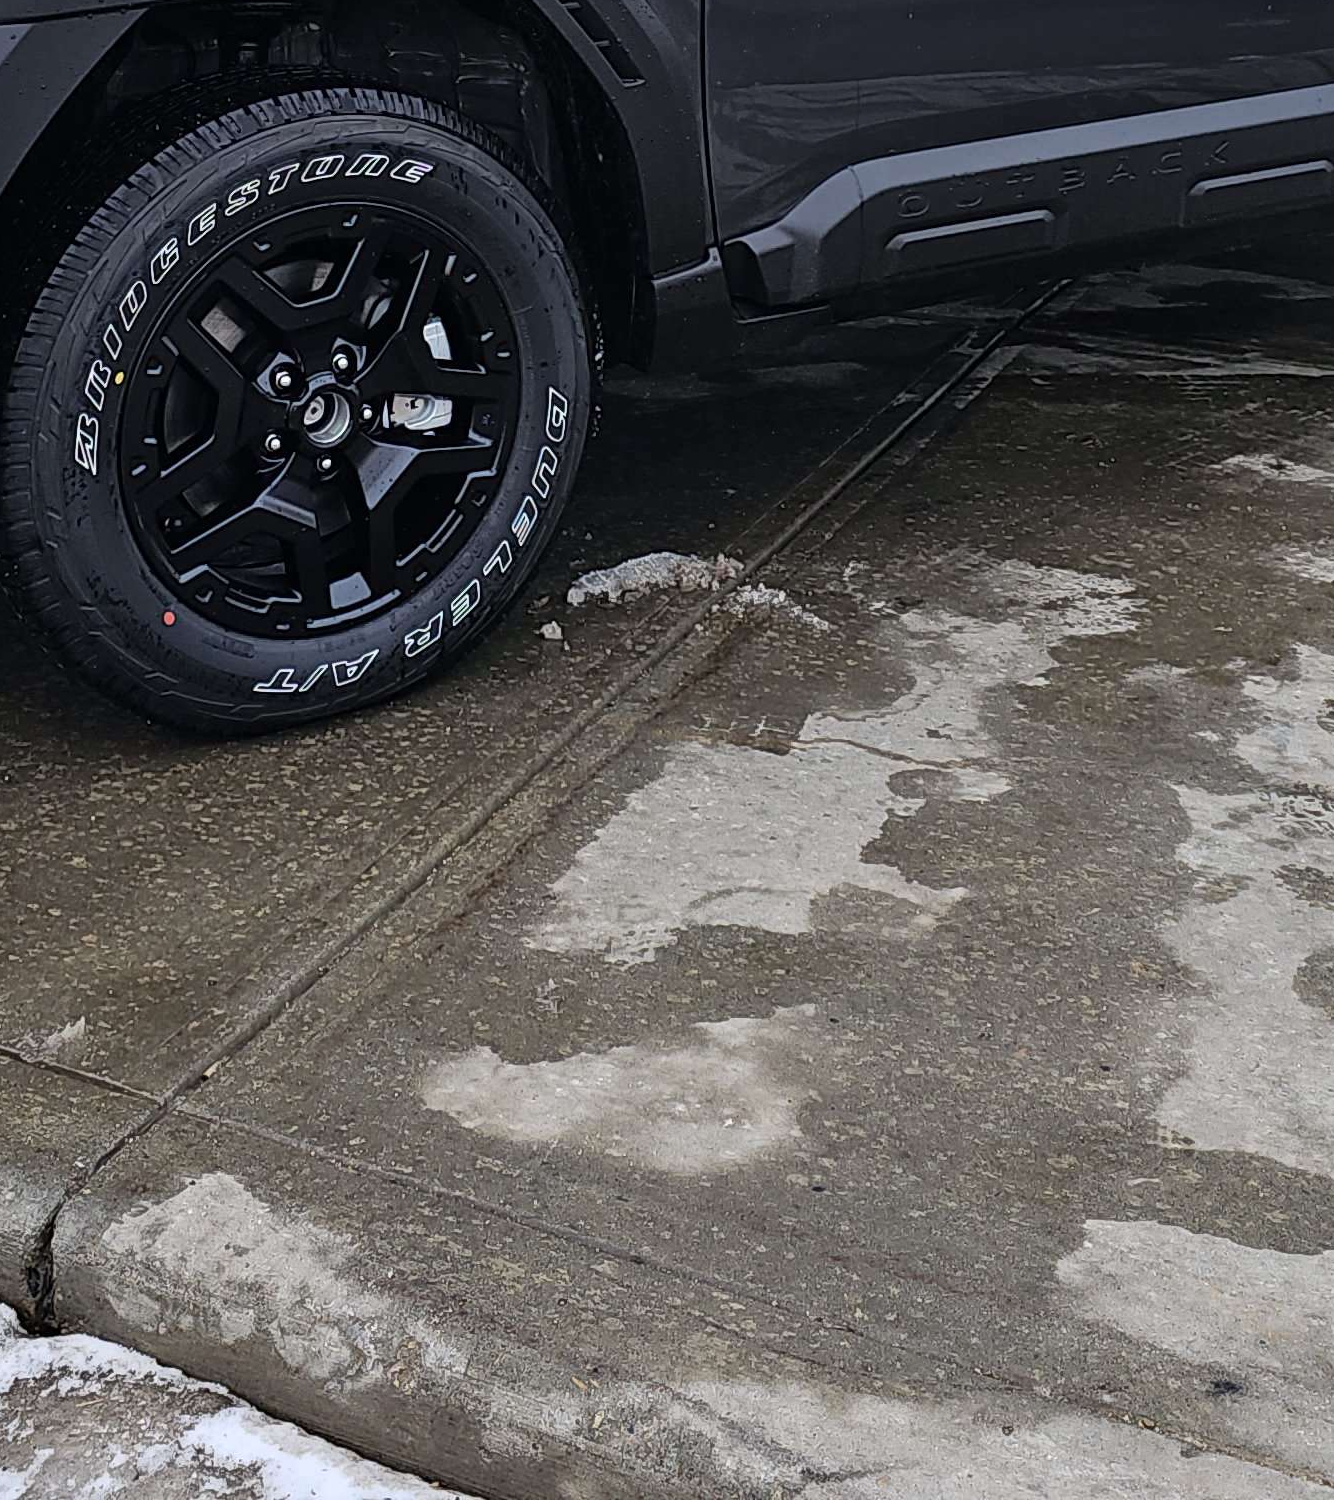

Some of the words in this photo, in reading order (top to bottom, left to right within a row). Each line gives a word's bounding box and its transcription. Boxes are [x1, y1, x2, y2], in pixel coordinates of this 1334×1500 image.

[74, 153, 434, 476] BRIDGESTONE
[404, 387, 568, 658] DUELER
[253, 649, 380, 693] A/T
